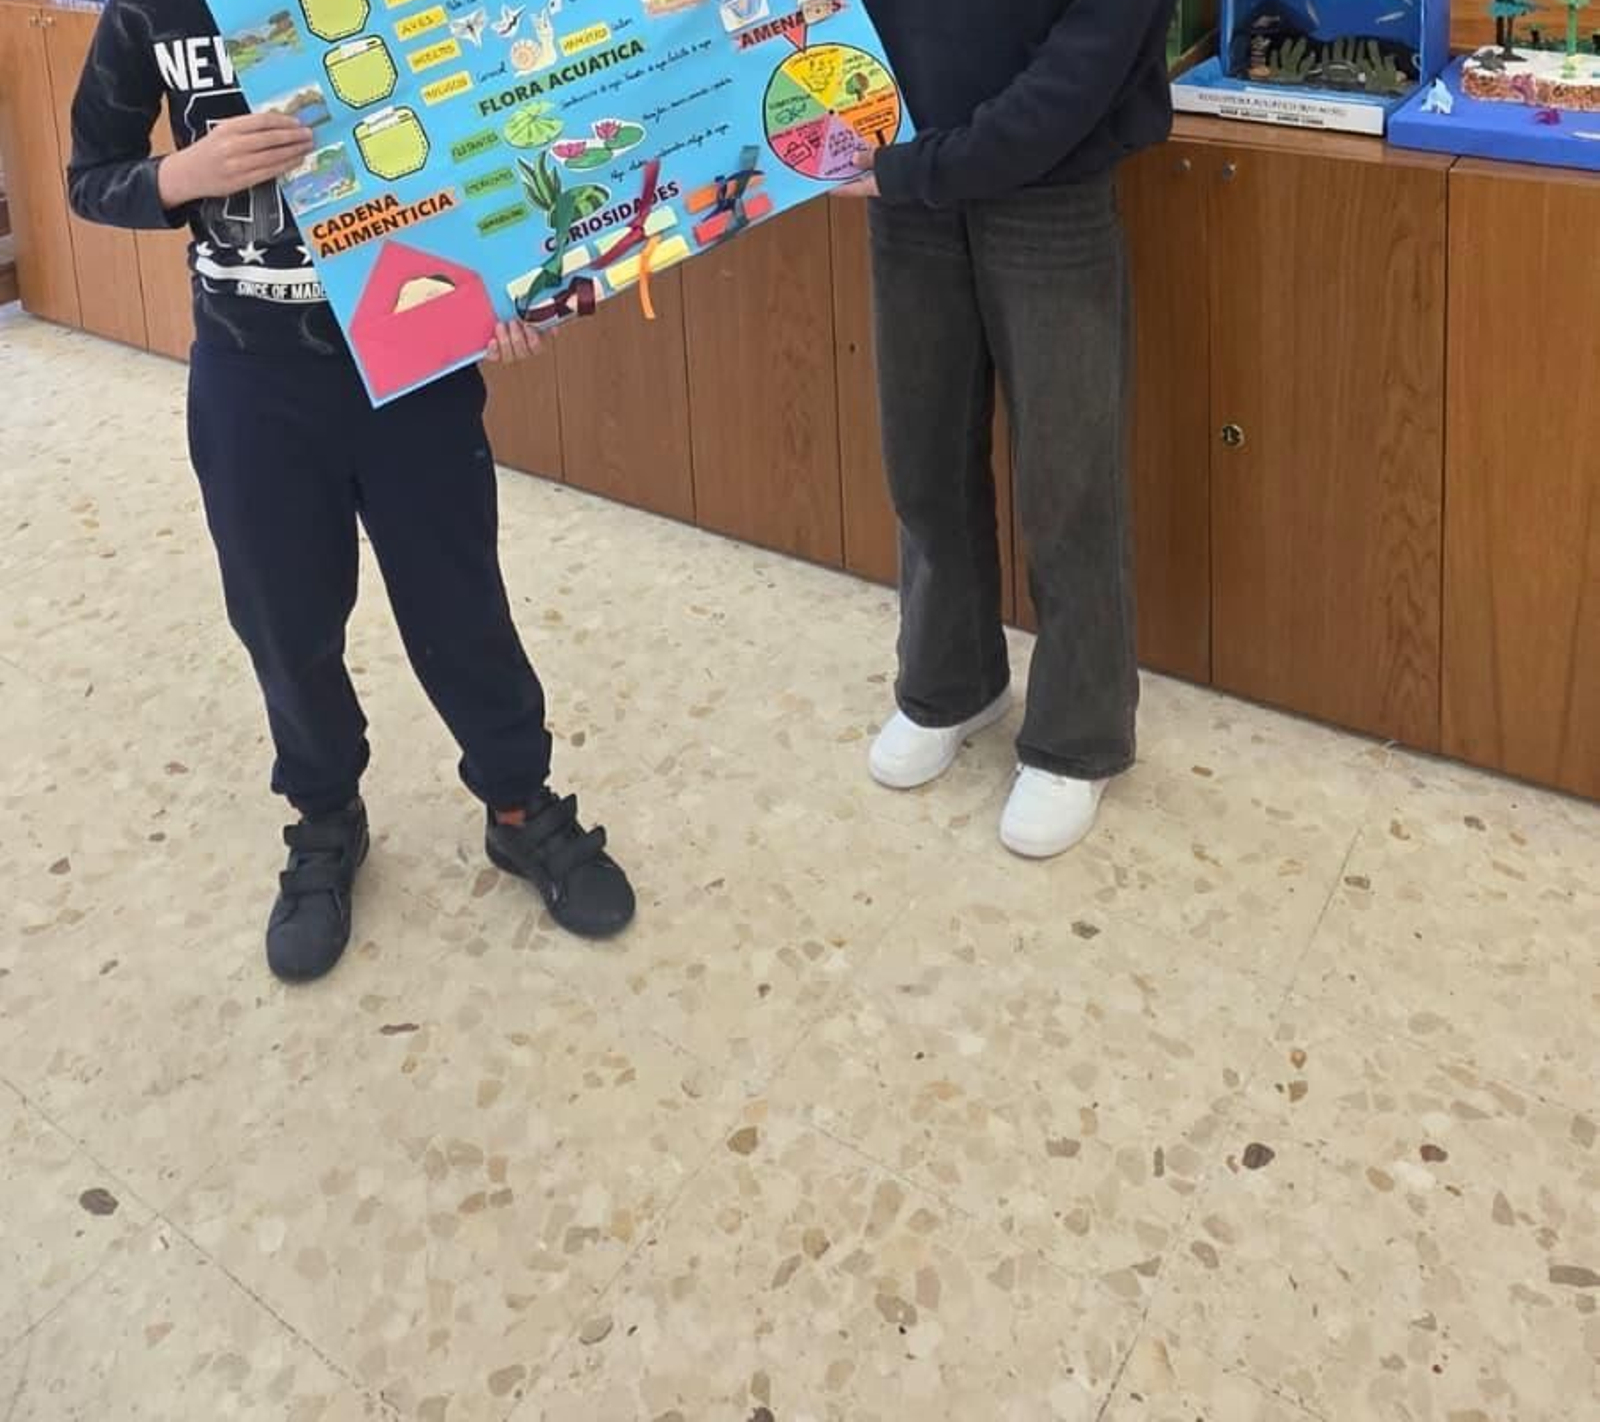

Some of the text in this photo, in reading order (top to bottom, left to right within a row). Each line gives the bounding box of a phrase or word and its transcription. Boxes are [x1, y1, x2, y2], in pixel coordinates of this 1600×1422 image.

[479, 81, 543, 117] FLORA
[550, 40, 644, 90] ACUATICA
[312, 194, 399, 240] CADENA
[320, 193, 453, 258] ALIMENTICIA
